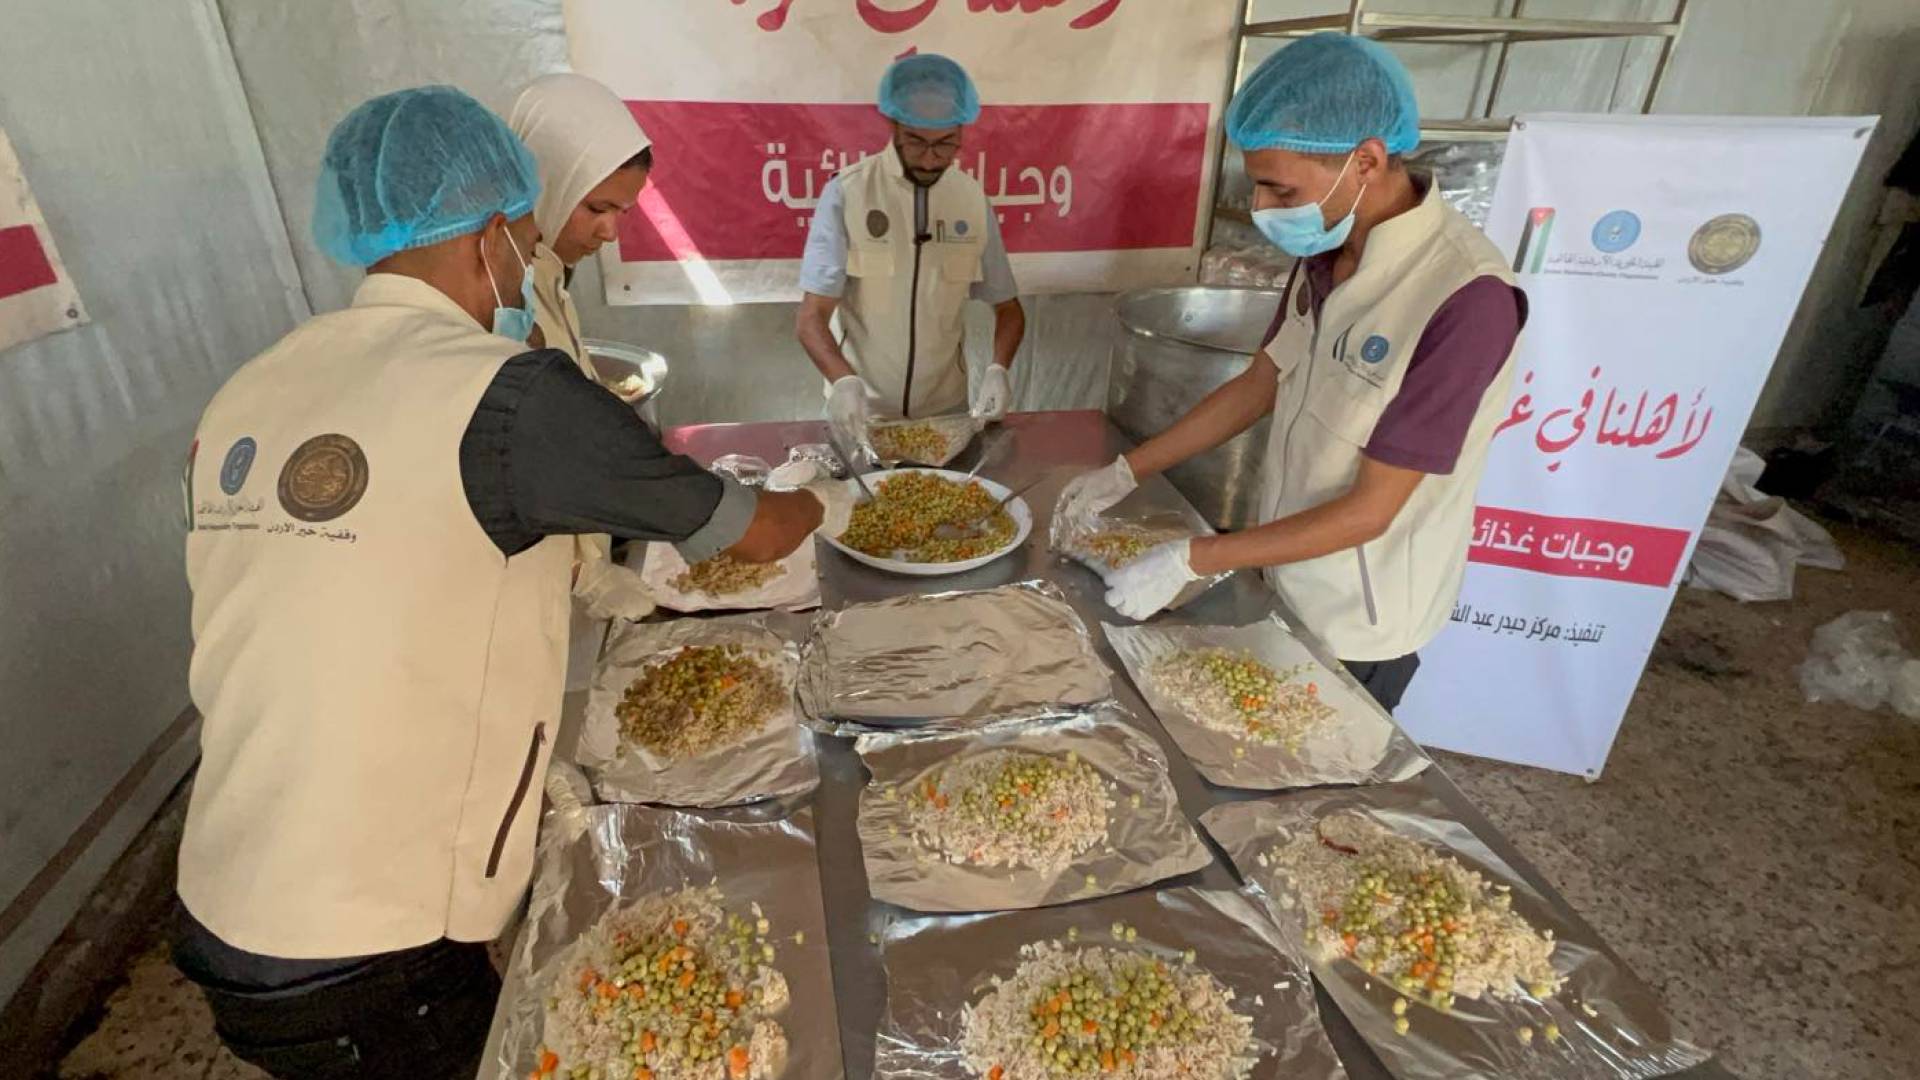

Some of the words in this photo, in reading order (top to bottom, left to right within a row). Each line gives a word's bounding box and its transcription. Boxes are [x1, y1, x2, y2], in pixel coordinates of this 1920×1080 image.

[955, 151, 1073, 222] وجبا
[1535, 366, 1601, 472] في
[1596, 386, 1713, 460] لأهلنا
[1471, 518, 1535, 554] غذائ
[1541, 531, 1634, 571] وجبات
[1450, 600, 1472, 624] الش
[1471, 610, 1495, 630] عبد
[1493, 615, 1527, 635] حيدر
[1525, 616, 1562, 641] مركز
[1563, 622, 1606, 647] تنفيذ:
